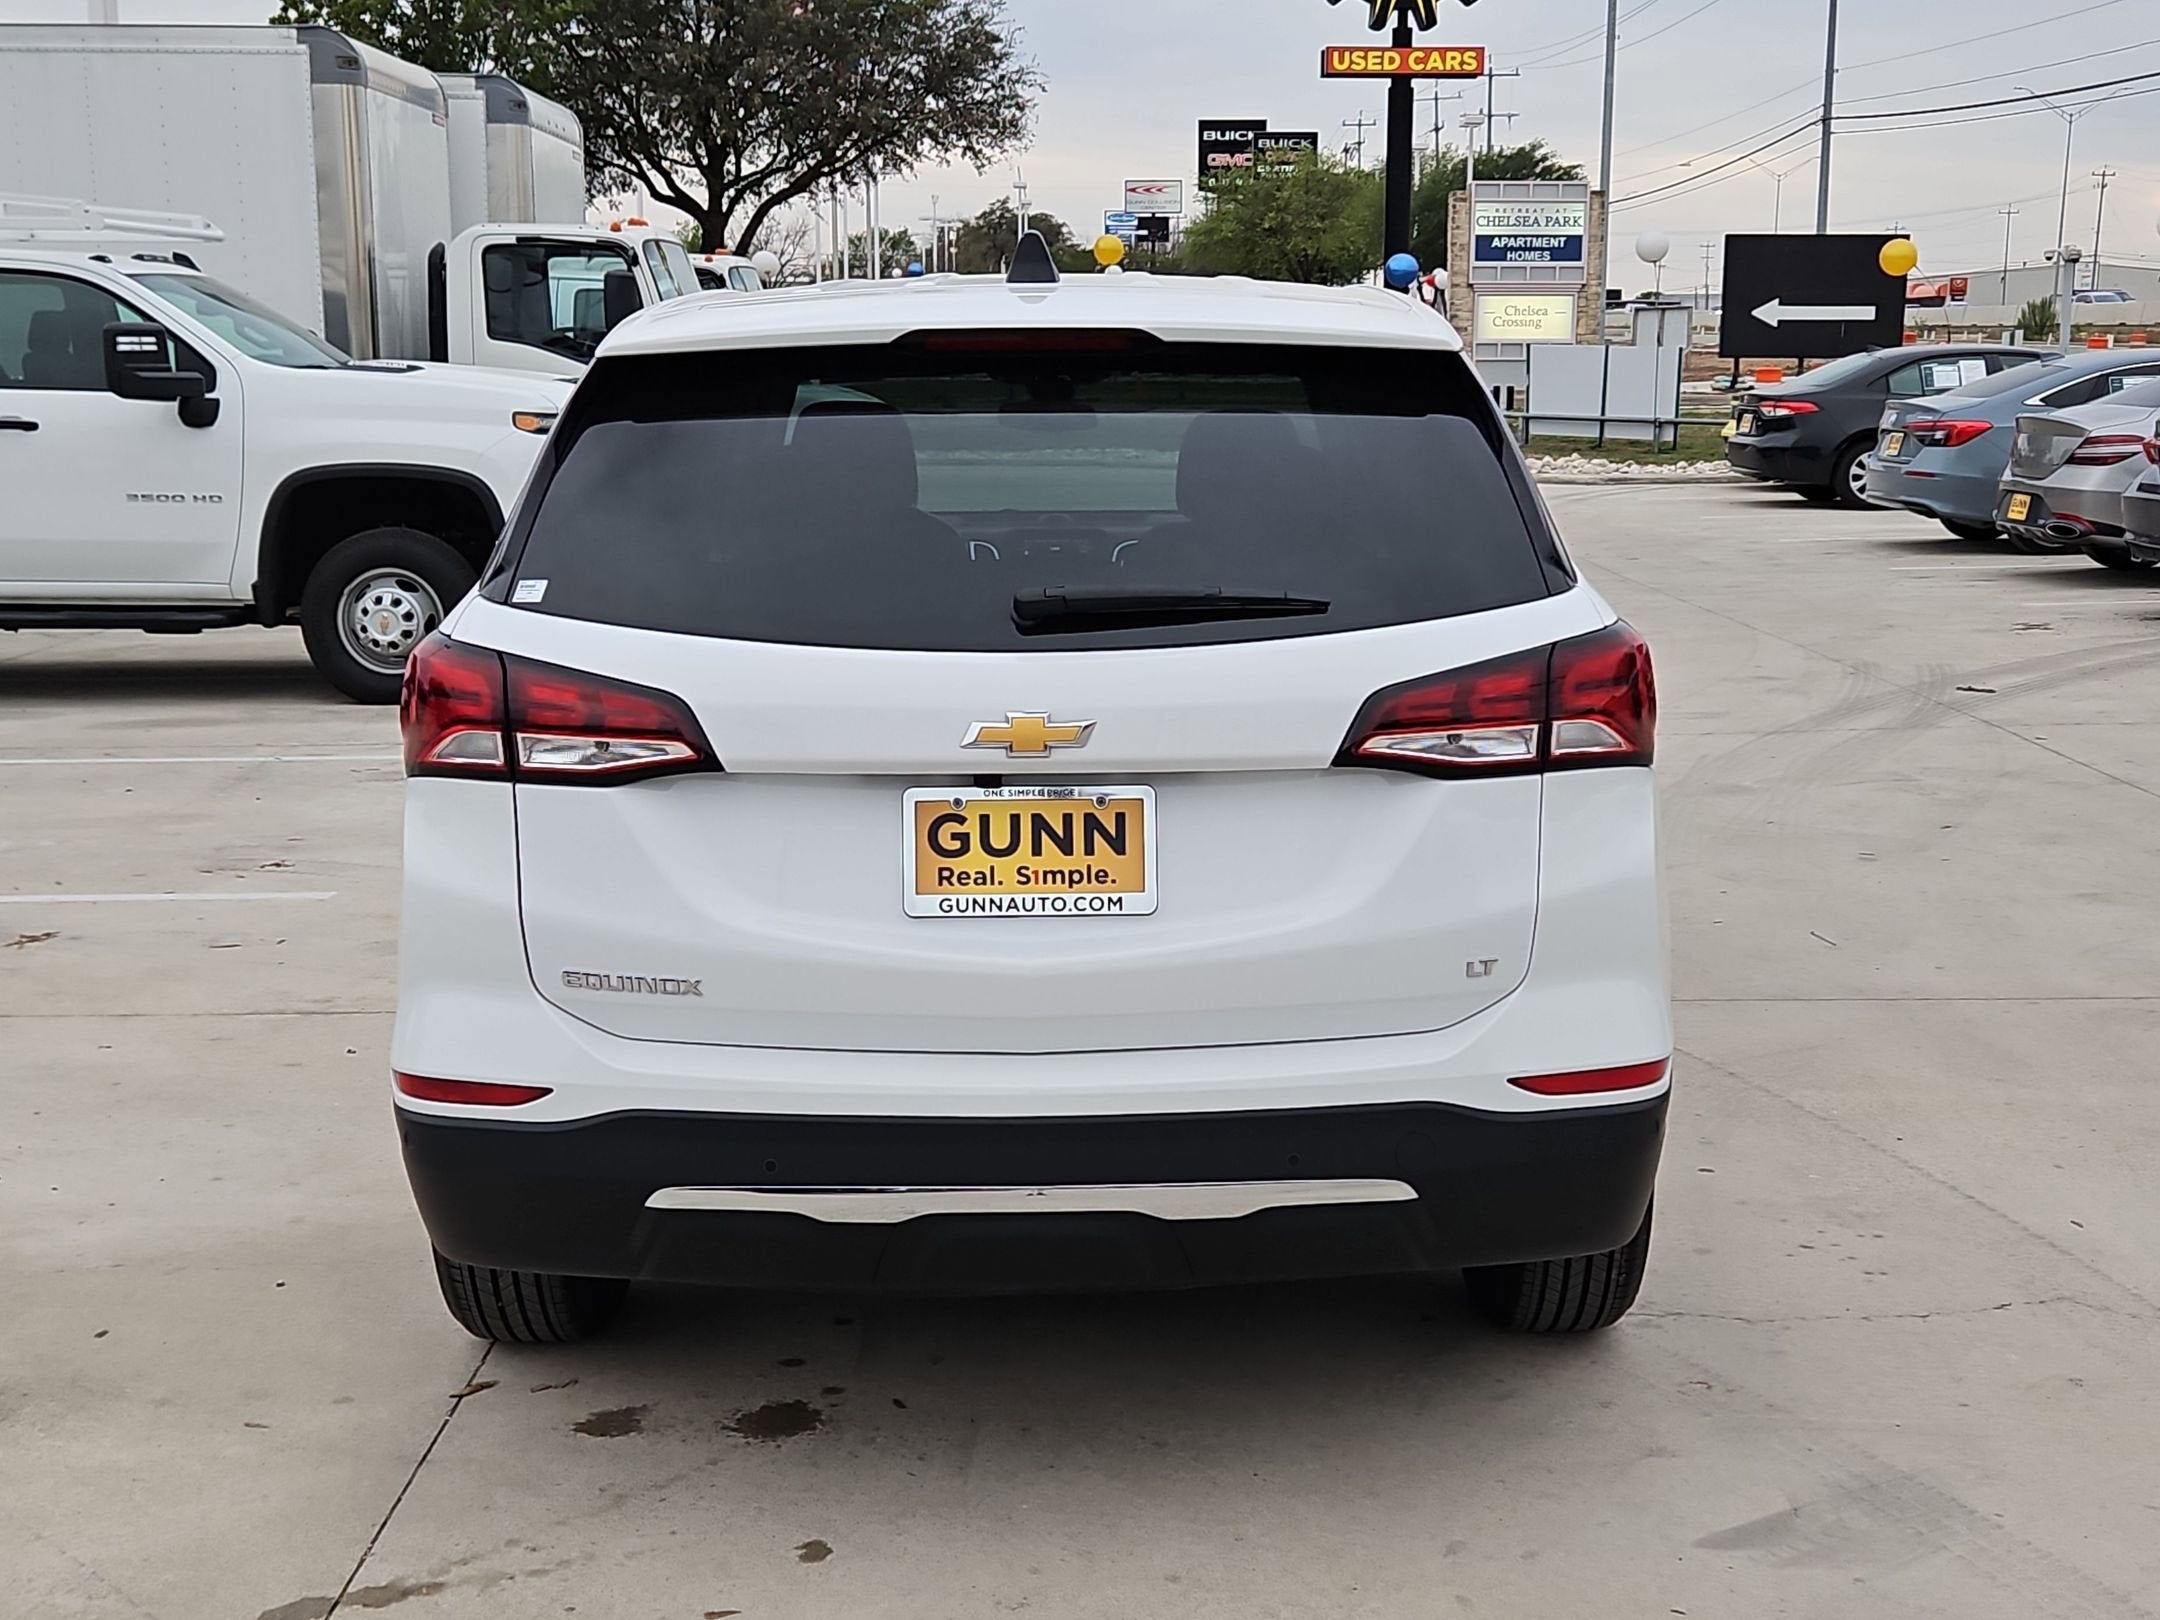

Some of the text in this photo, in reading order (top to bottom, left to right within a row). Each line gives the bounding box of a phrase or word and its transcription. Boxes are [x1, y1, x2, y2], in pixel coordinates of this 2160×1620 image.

[1332, 50, 1478, 71] USED CARS
[1257, 138, 1314, 149] BUICK
[1207, 153, 1253, 167] GMC
[1476, 215, 1583, 228] CHELSEA PARK
[1490, 236, 1567, 248] APARTMENT
[1506, 250, 1551, 261] HOMES
[1504, 304, 1549, 317] Chelsea
[1492, 315, 1542, 330] Crossing
[192, 494, 223, 504] HD
[983, 789, 1005, 798] ONE
[927, 812, 1127, 859] GUNN
[937, 864, 1004, 887] Real.
[938, 896, 1124, 914] GUNNAUTO.COM
[1465, 958, 1499, 978] LT
[561, 970, 704, 997] EQUINOX
